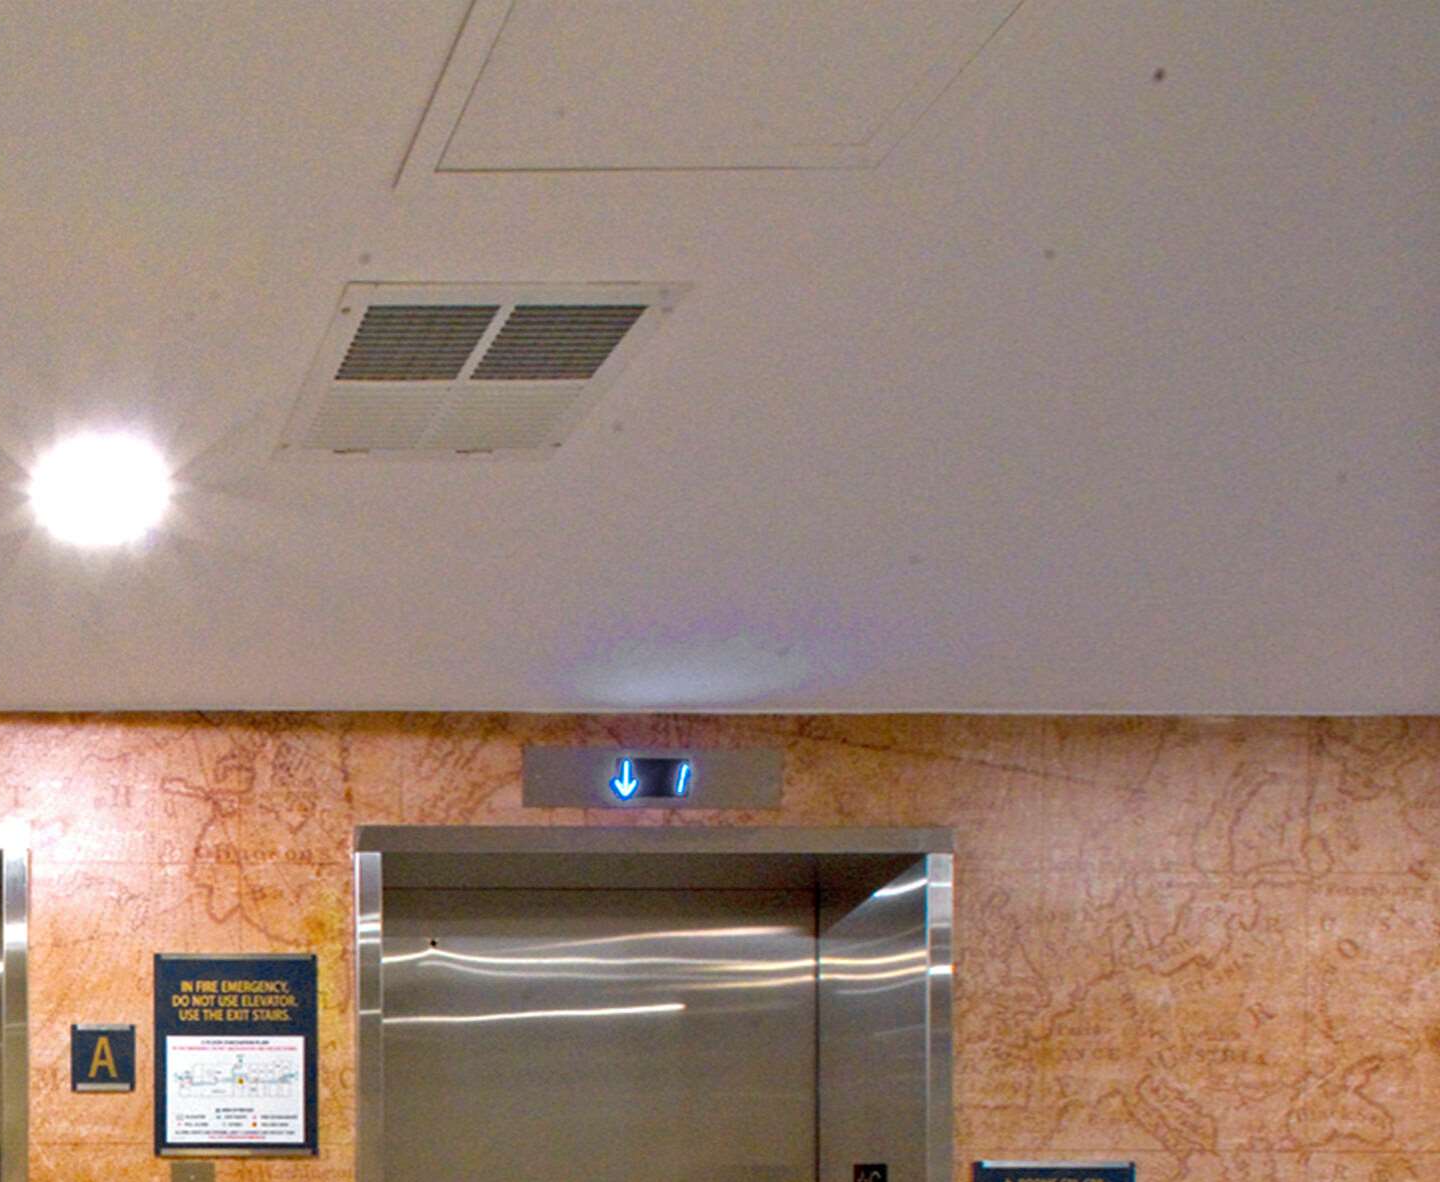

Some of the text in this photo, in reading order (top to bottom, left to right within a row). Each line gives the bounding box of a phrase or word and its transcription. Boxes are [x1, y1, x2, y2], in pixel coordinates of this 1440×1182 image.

[676, 763, 690, 797] 1
[181, 980, 193, 993] IN
[195, 980, 218, 993] FIRE
[172, 994, 190, 1007] DO
[192, 994, 216, 1007] NOT
[219, 994, 239, 1007] USE
[179, 1008, 200, 1021] USE
[203, 1008, 224, 1021] THE
[227, 1008, 249, 1021] EXIT
[88, 1036, 118, 1078] A
